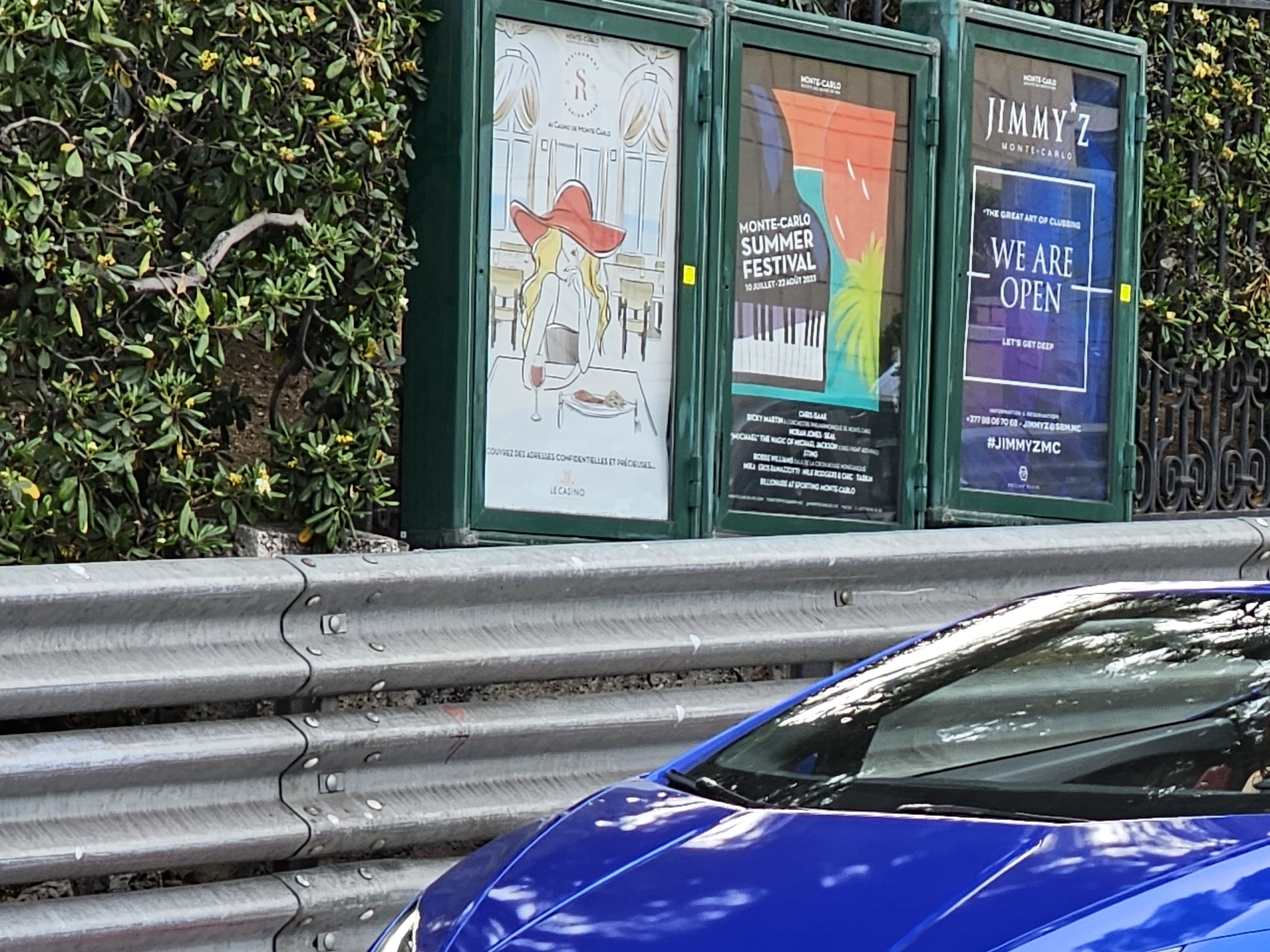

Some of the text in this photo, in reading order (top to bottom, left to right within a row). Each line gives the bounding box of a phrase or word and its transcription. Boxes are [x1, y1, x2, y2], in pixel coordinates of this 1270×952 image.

[801, 75, 841, 90] MONTE-CARLO
[1023, 74, 1057, 86] MONTE-CARLO
[1002, 142, 1073, 160] MONTE-CARLO
[739, 213, 811, 234] MONTE-CARLO
[1000, 211, 1024, 221] GREAT
[1024, 214, 1038, 223] ART
[1038, 215, 1049, 224] OF
[1049, 217, 1081, 230] CLUBBING
[741, 229, 814, 256] SUMMER
[742, 251, 817, 279] FESTIVAL
[991, 236, 1074, 278] WE ARE
[745, 283, 753, 291] 10
[753, 280, 776, 290] JUILLET
[786, 274, 801, 285] AOÛT
[1000, 276, 1062, 314] OPEN
[1002, 337, 1054, 351] LET'S GET DEEP
[986, 436, 1061, 455] #JIMMYZMC
[514, 450, 525, 459] DES
[526, 451, 555, 461] ADRESSES
[558, 487, 585, 497] CASINO
